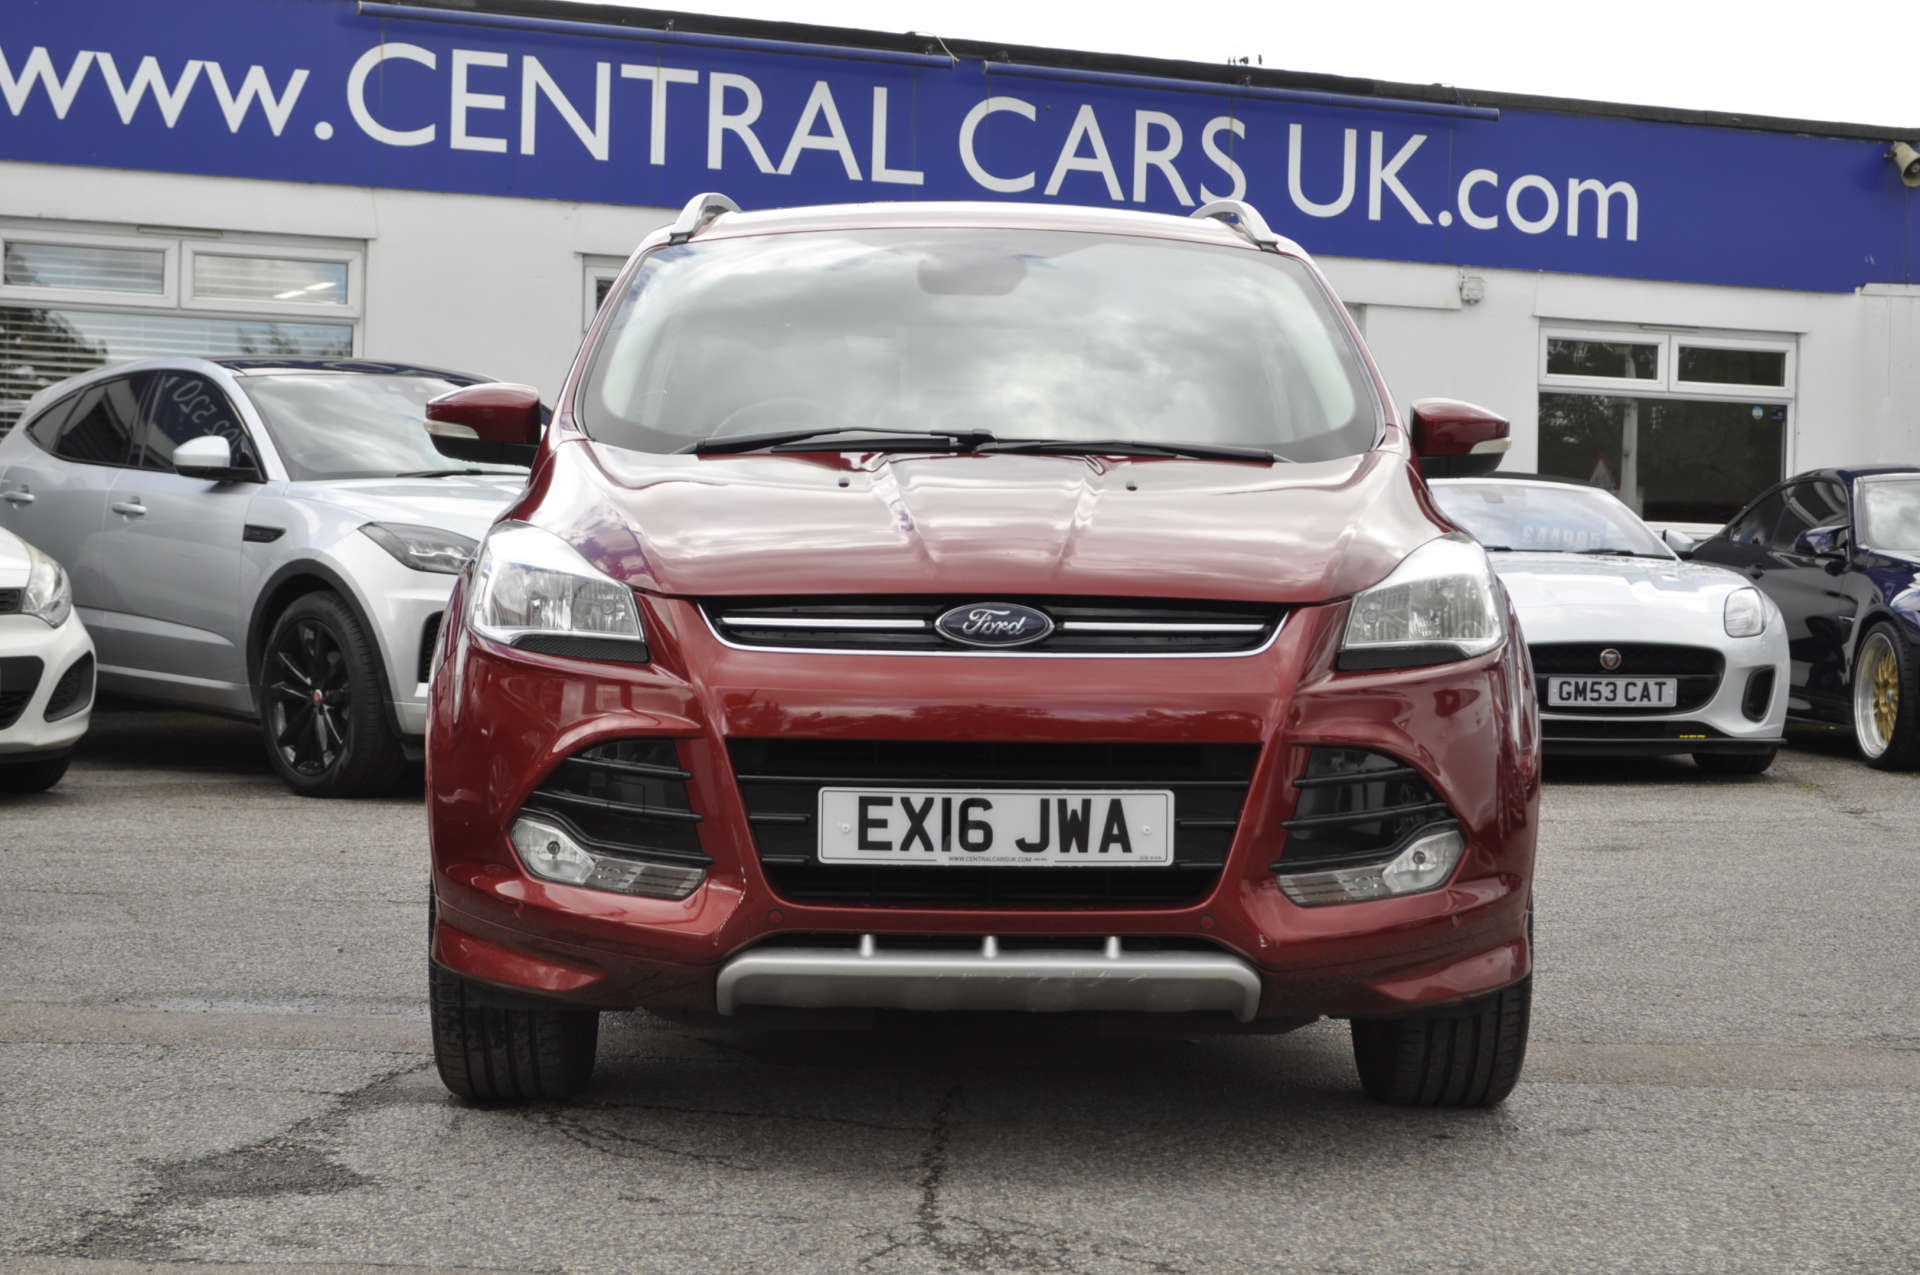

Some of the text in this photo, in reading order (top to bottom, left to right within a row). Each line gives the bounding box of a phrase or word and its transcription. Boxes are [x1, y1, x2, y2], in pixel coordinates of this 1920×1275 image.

[959, 96, 1247, 207] CARS
[1287, 122, 1639, 241] UK.com
[962, 608, 1027, 635] Ford
[1558, 681, 1667, 702] GM53 CAT
[857, 795, 1133, 854] EX16 JWA
